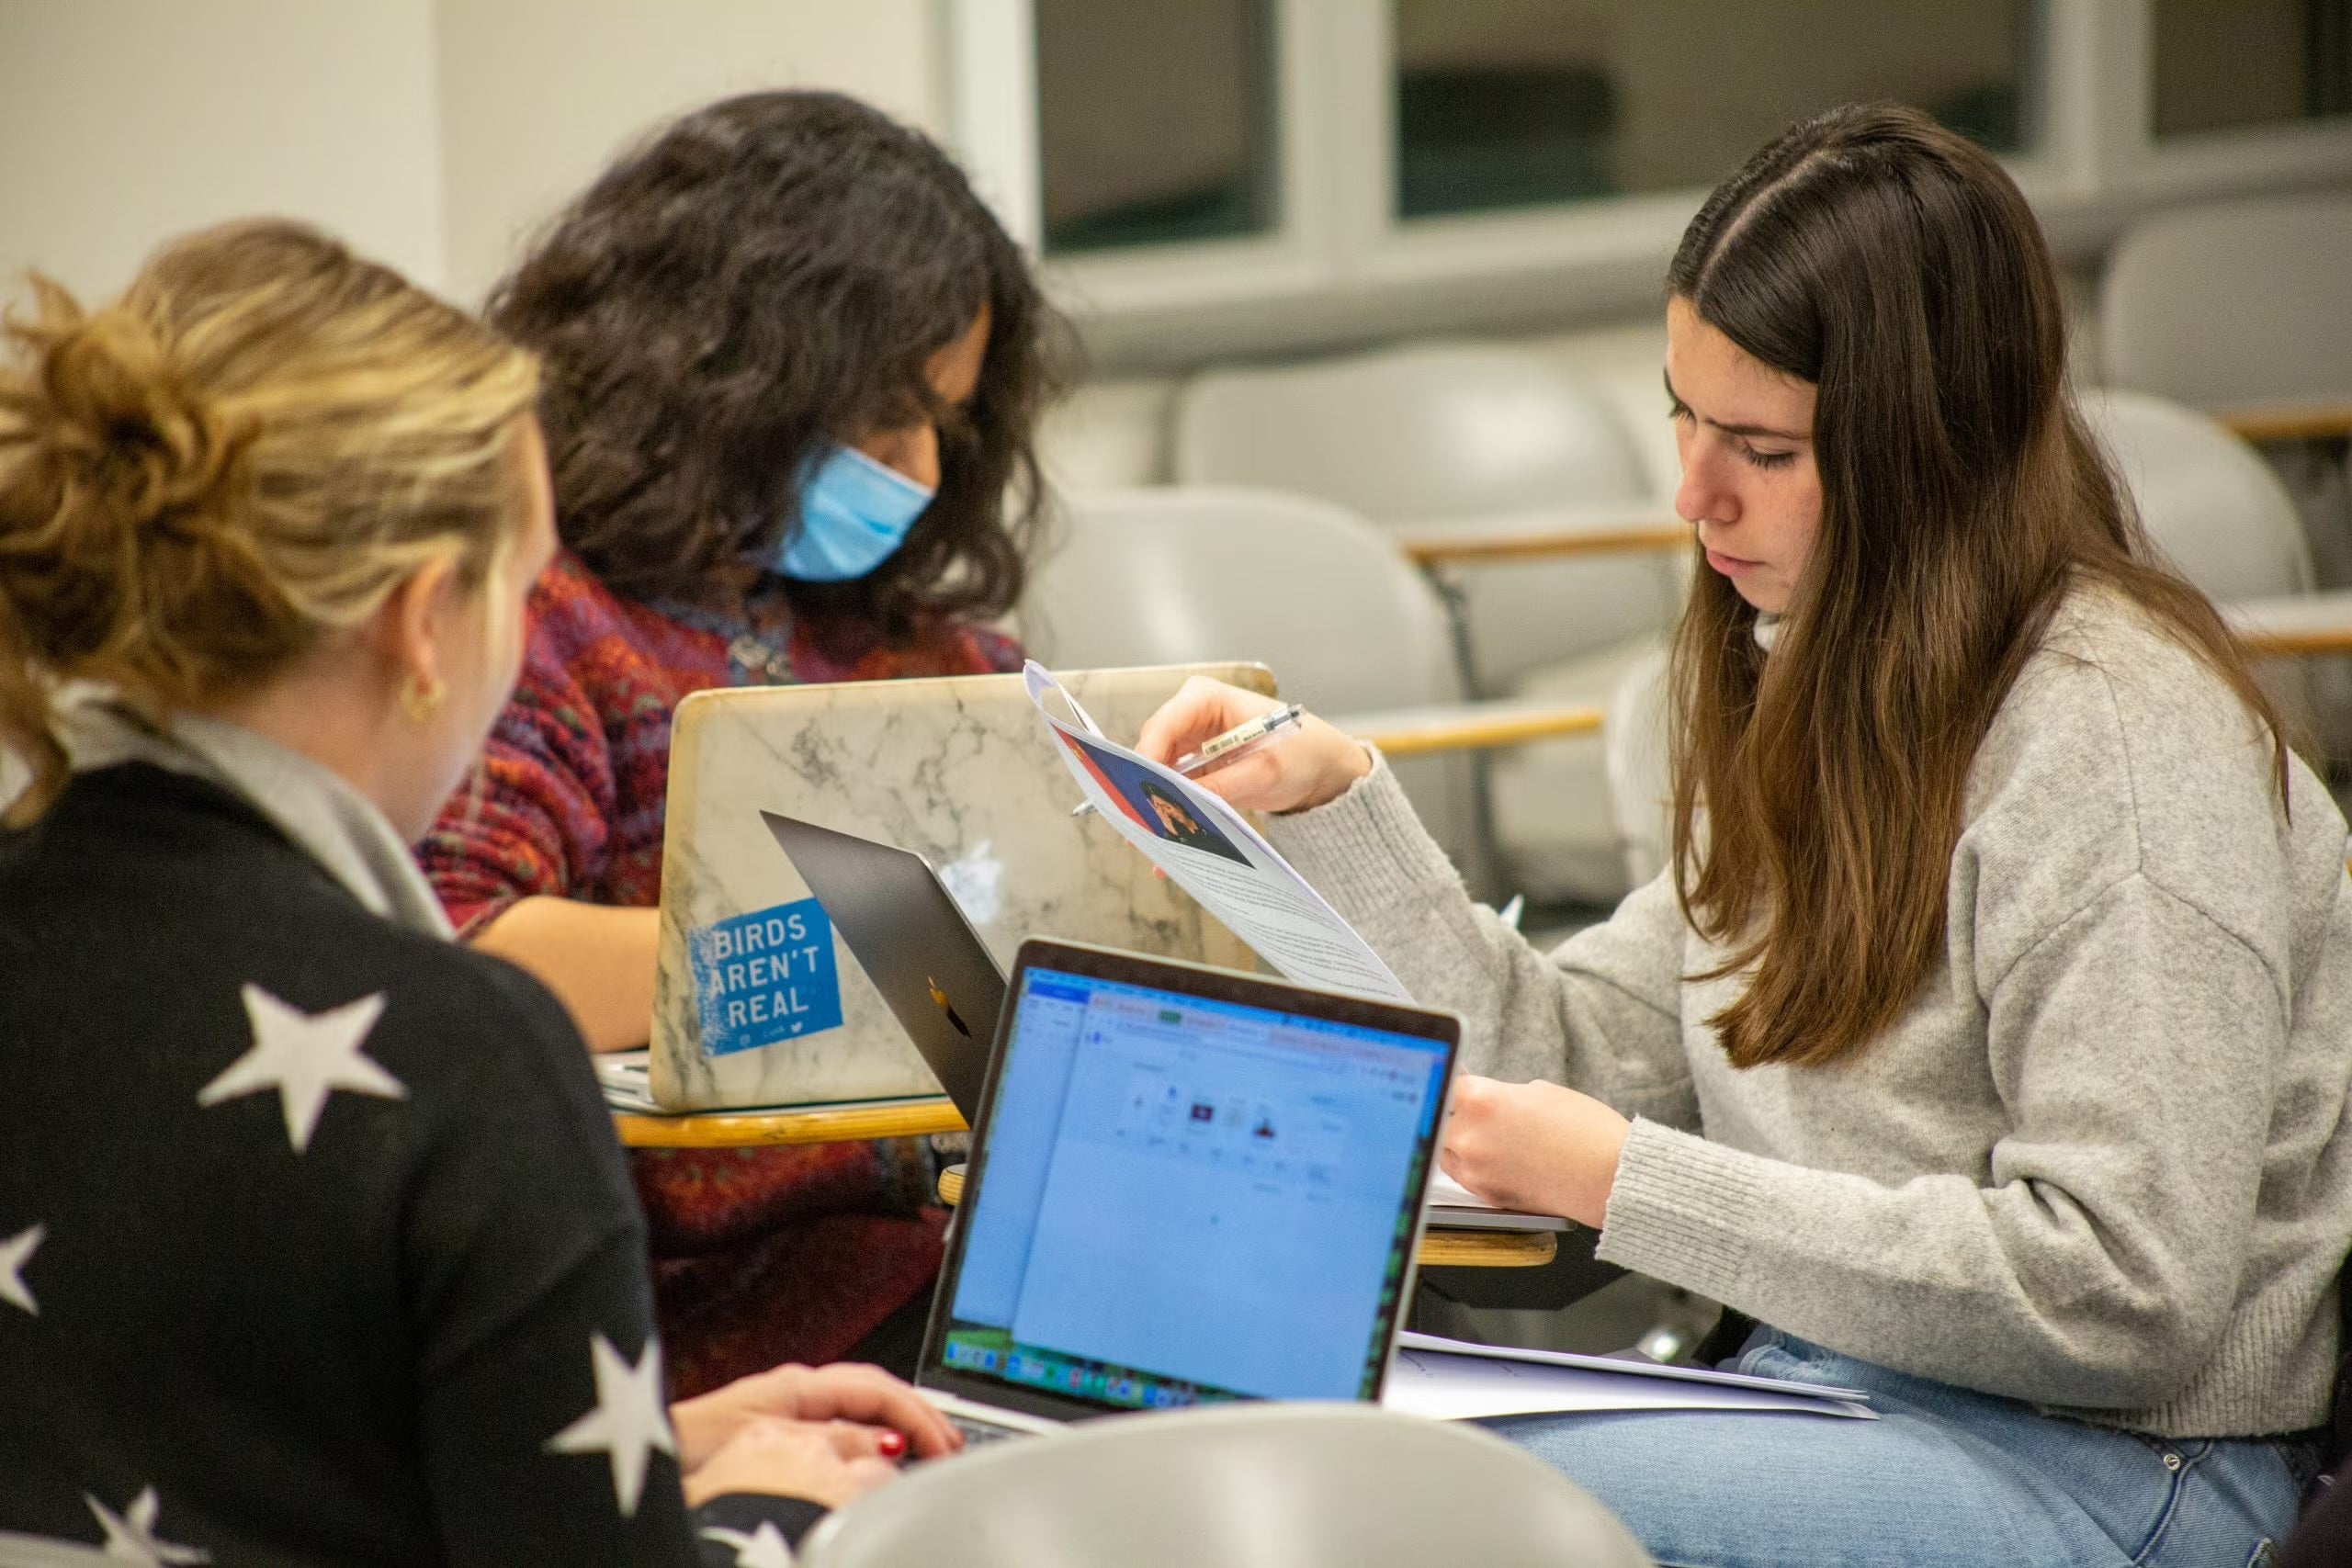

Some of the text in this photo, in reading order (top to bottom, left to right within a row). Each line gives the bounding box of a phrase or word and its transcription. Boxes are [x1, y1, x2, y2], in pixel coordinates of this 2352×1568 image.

[713, 914, 807, 960] BIRDS
[709, 946, 819, 999] AREN'T
[728, 987, 808, 1028] REAL
